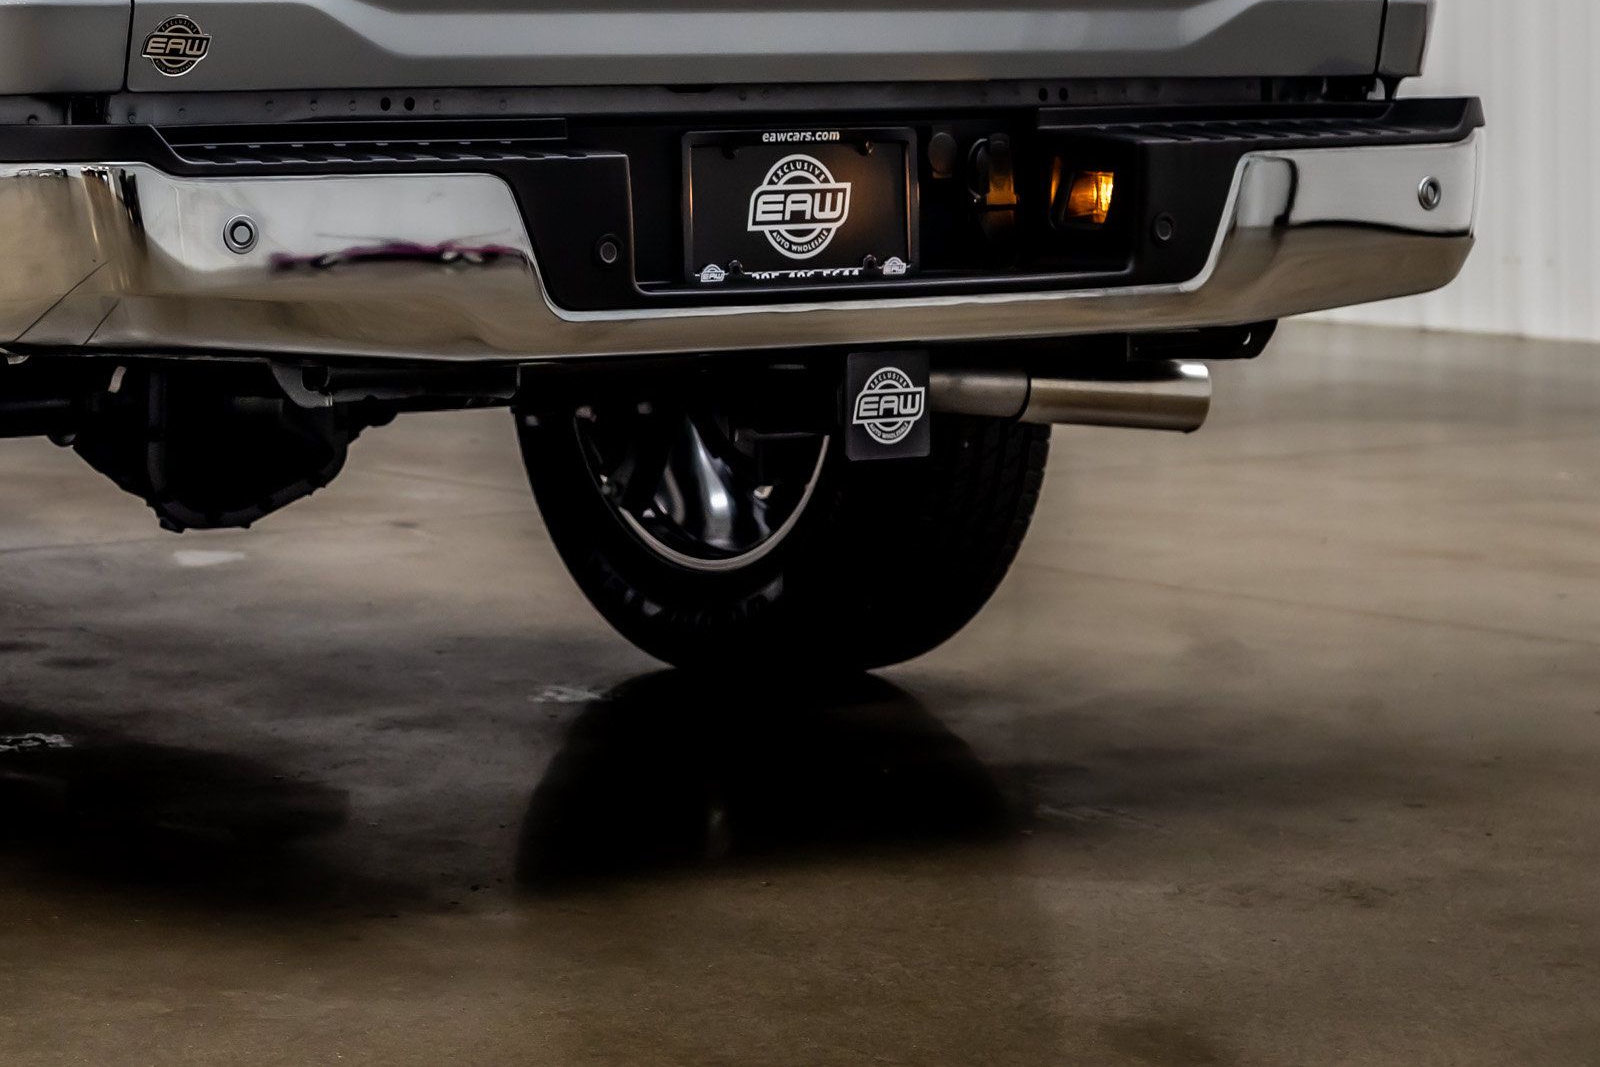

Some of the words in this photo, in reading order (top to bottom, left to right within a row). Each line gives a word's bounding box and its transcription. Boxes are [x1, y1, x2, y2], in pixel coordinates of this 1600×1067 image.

[161, 19, 198, 33] EXCLUSIVE
[146, 37, 207, 55] EAW
[762, 131, 841, 143] eawcars.com
[771, 160, 826, 184] EXCLUSIVE
[755, 191, 844, 222] EAW
[771, 231, 790, 249] AUTO
[791, 228, 829, 253] WHOLESALE
[870, 372, 908, 389] EXCLUSIVE
[859, 394, 920, 417] EAW
